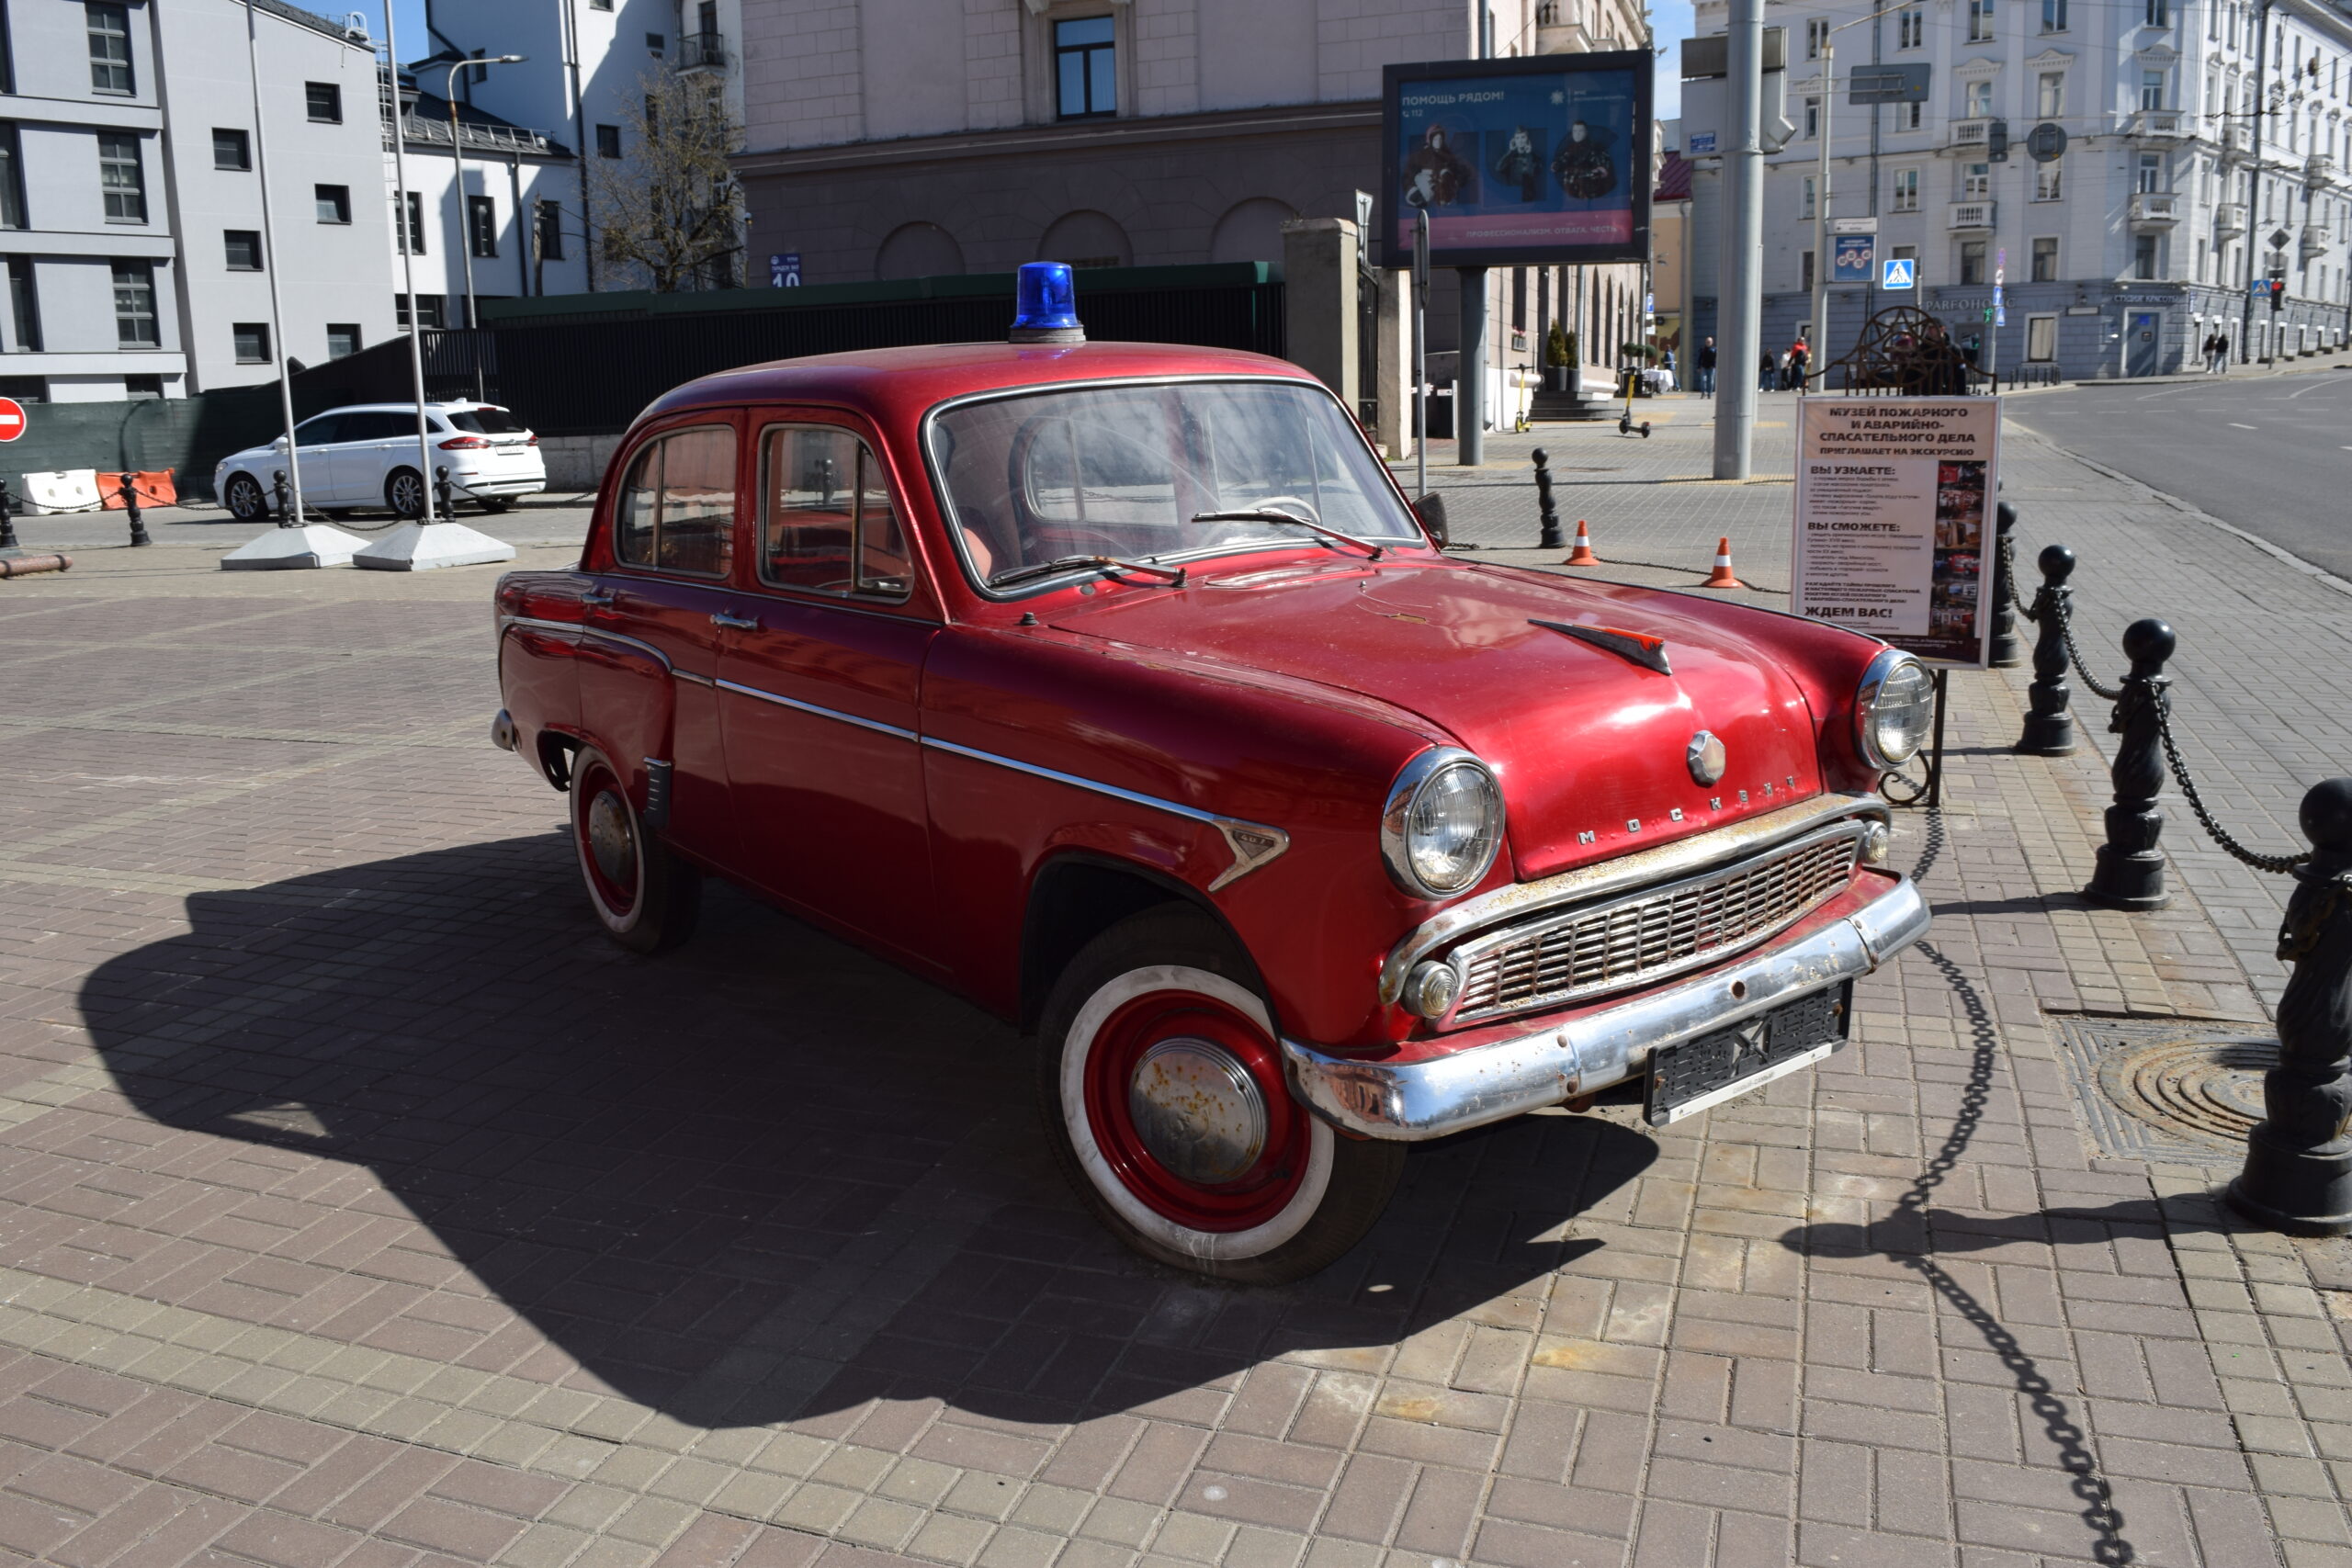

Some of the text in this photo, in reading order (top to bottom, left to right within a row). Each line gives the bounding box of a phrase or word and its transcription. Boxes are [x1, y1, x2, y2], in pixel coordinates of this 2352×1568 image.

[1402, 91, 1504, 107] ПОМОЩЬ РЯДОМ!
[773, 272, 799, 287] 10
[1926, 298, 2016, 310] PARFOHOC
[1829, 406, 1968, 417] МУЗЕЙ ПОЖАРНОГО
[1850, 419, 1945, 430] И АВАРИЙНО-
[1819, 433, 1975, 444] СПАСАТЕЛЬНОГО ДЕЛА
[1820, 447, 1892, 456] ПРИГЛАШАЕТ
[1810, 466, 1895, 475] ВЫ УЗНАЕТЕ:
[1807, 522, 1900, 532] ВЫ СМОЖЕТЕ:
[1804, 606, 1893, 618] ЖДЕМ ВАС!
